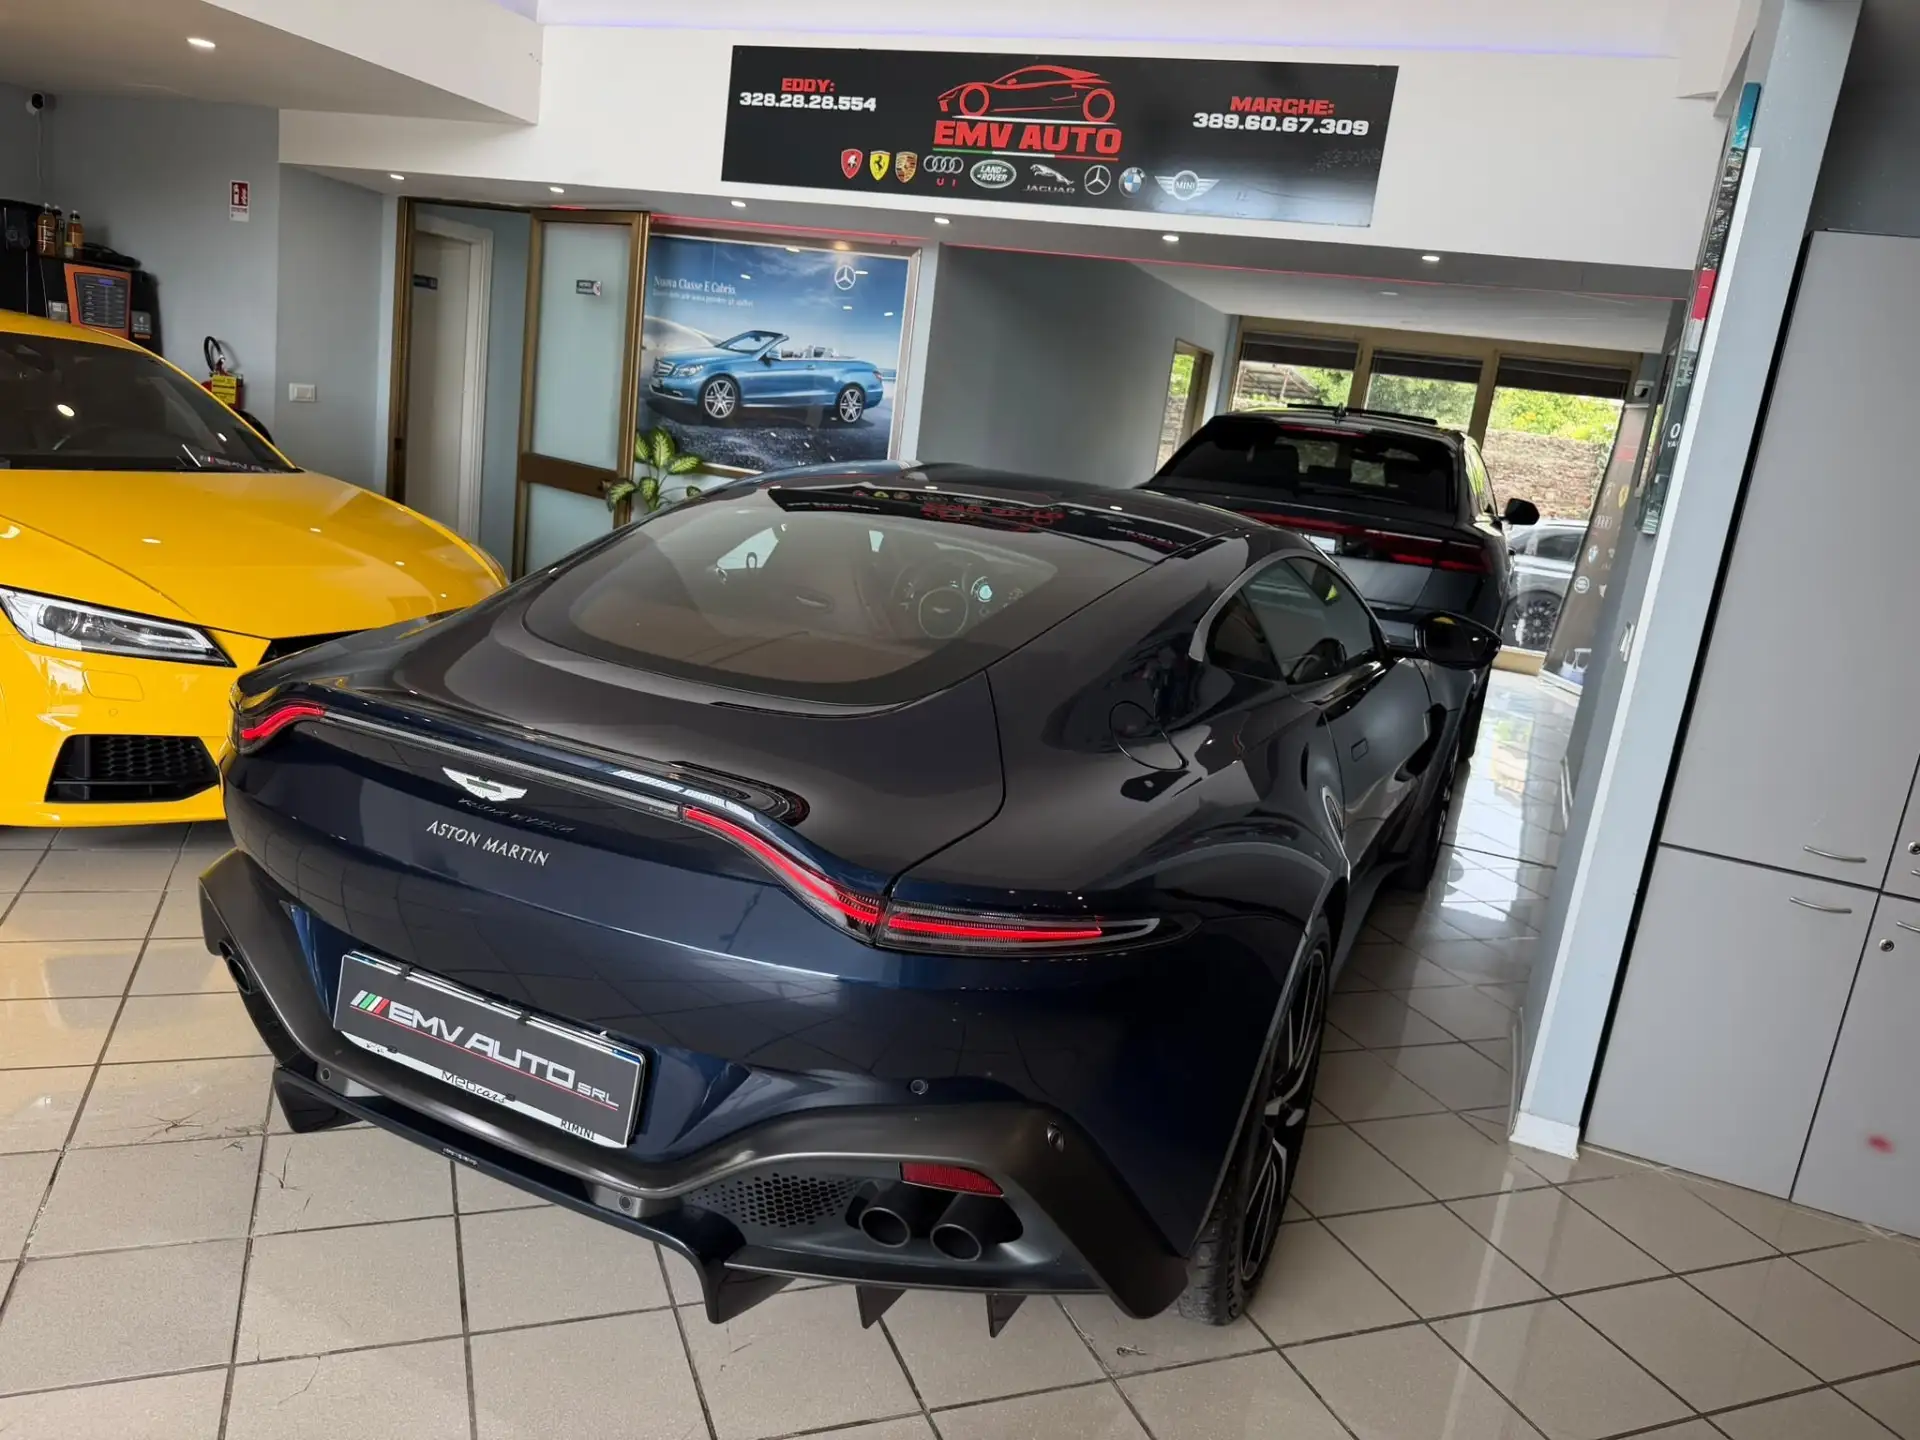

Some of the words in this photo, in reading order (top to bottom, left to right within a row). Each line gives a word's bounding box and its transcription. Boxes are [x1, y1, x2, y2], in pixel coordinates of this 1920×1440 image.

[782, 78, 835, 92] EDDY:
[740, 92, 876, 111] 328.28.28.554
[1192, 112, 1370, 136] 389.60.67.309
[933, 120, 1013, 148] EMV
[1018, 125, 1122, 154] AUTO
[981, 165, 1002, 174] LAND
[981, 173, 1008, 181] ROVER
[1025, 184, 1076, 194] JAGUAR
[1176, 181, 1196, 190] MINI
[426, 820, 481, 848] ASTON
[482, 836, 549, 867] MARTIN
[387, 1002, 464, 1043] EMV
[465, 1032, 576, 1090] AUTO
[577, 1081, 620, 1108] SRL
[560, 1119, 595, 1140] RIMINI
